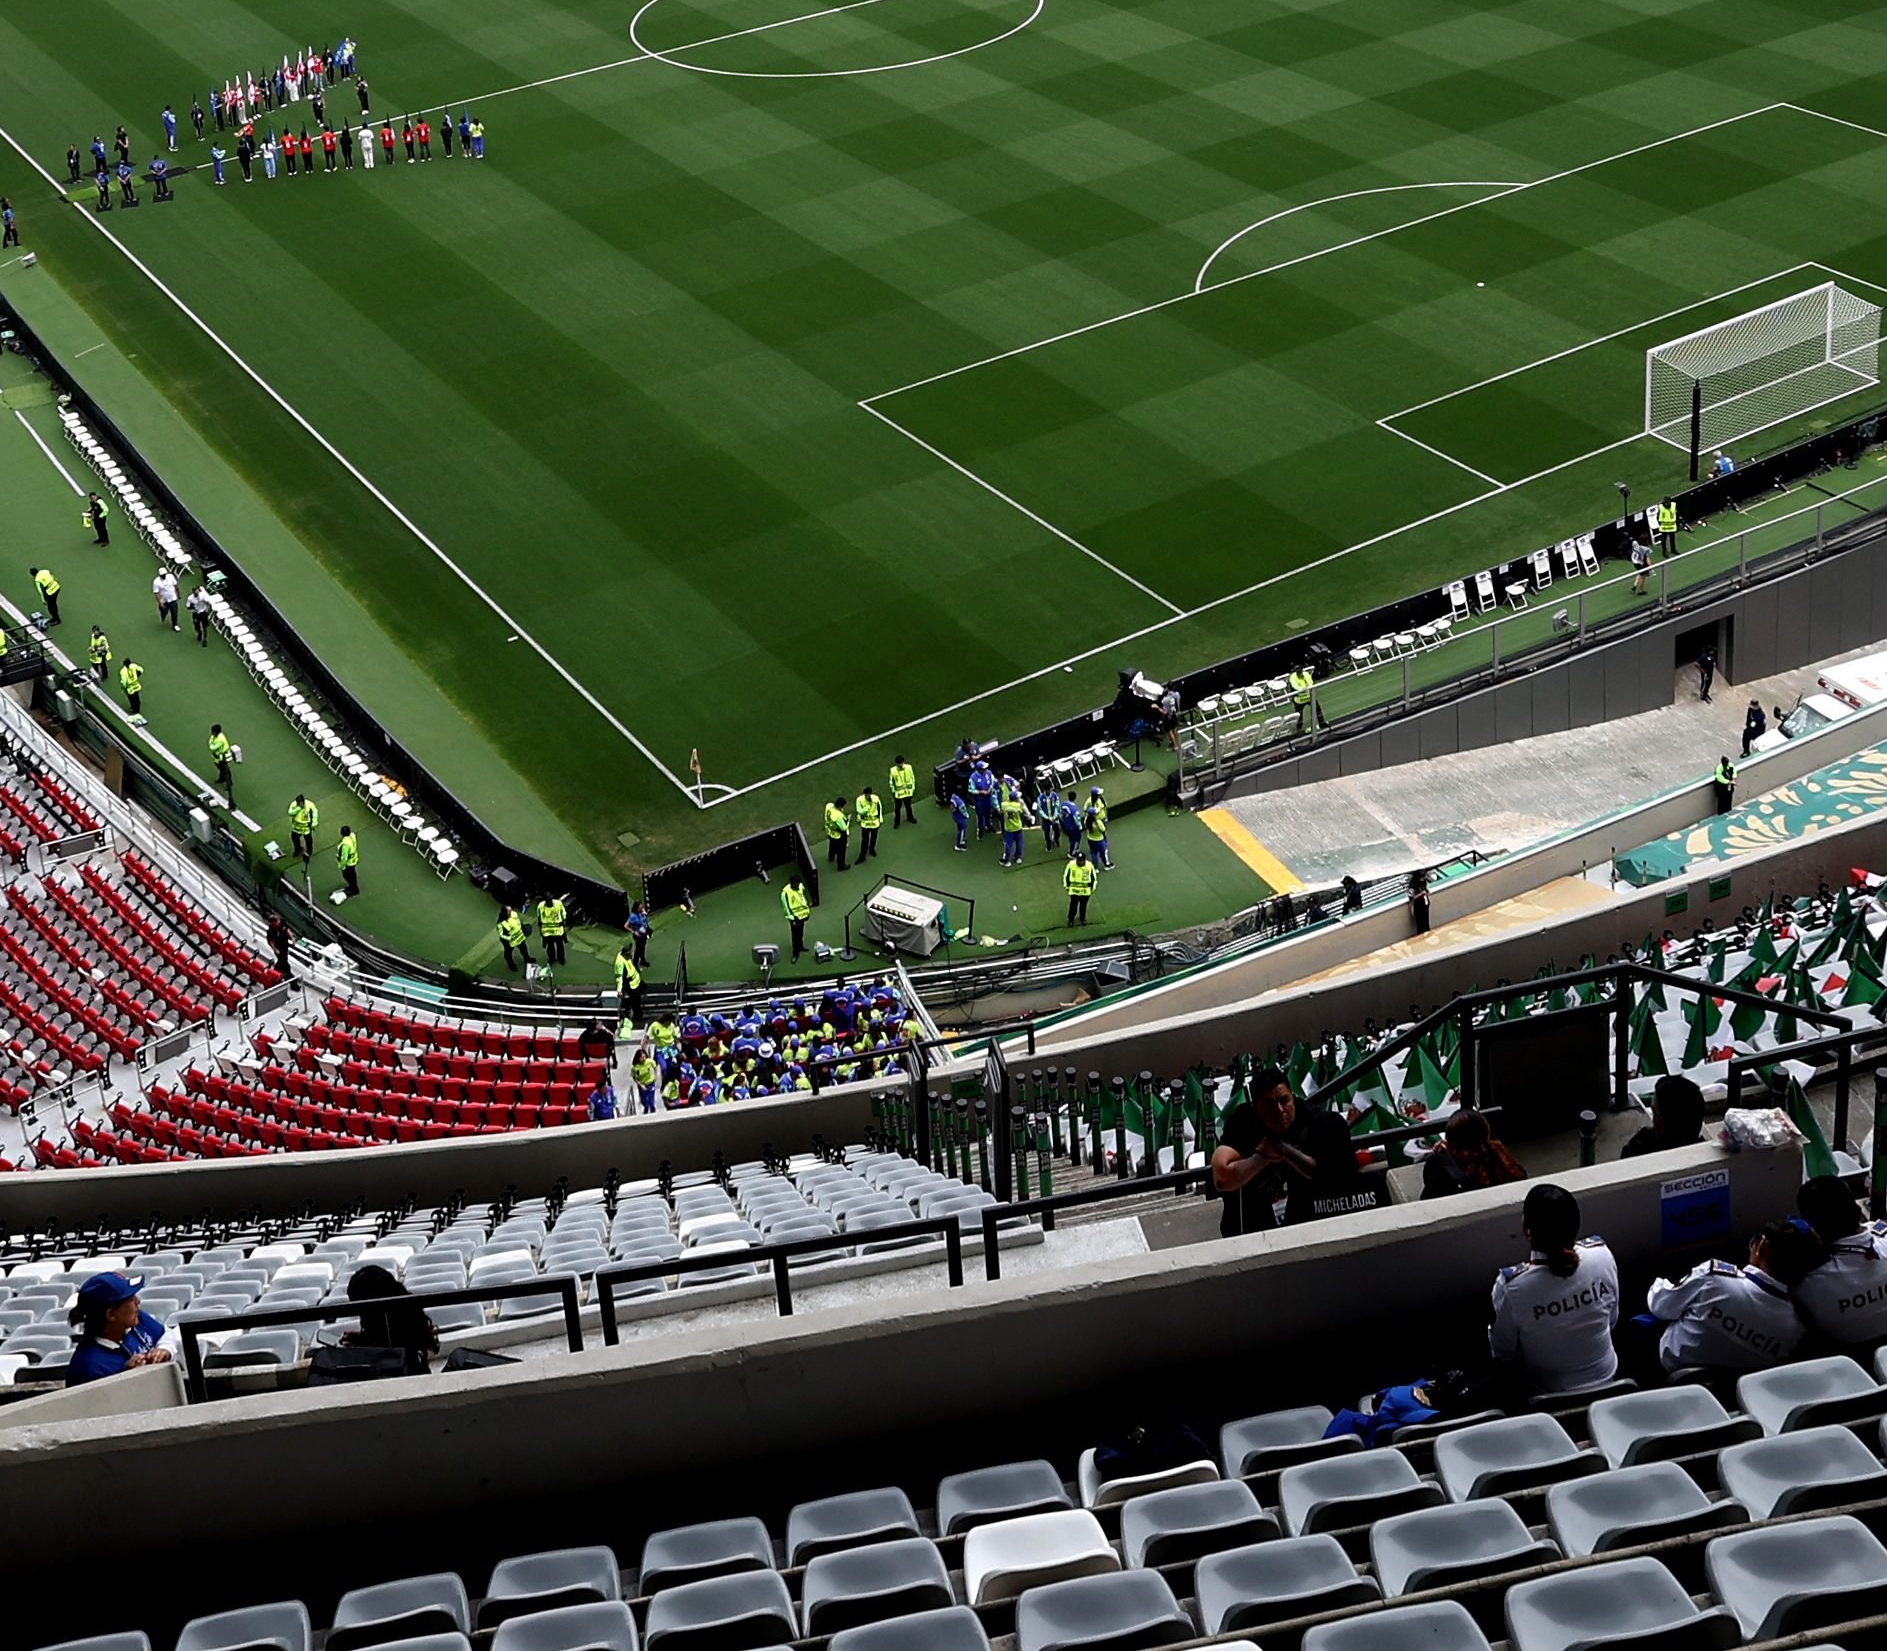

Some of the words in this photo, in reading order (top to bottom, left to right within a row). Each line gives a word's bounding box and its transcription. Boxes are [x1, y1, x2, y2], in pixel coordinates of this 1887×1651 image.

[1313, 1190, 1377, 1214] MICHELADAS
[1531, 1280, 1611, 1321] POLICÍA
[1708, 1305, 1782, 1356] POLICÍA
